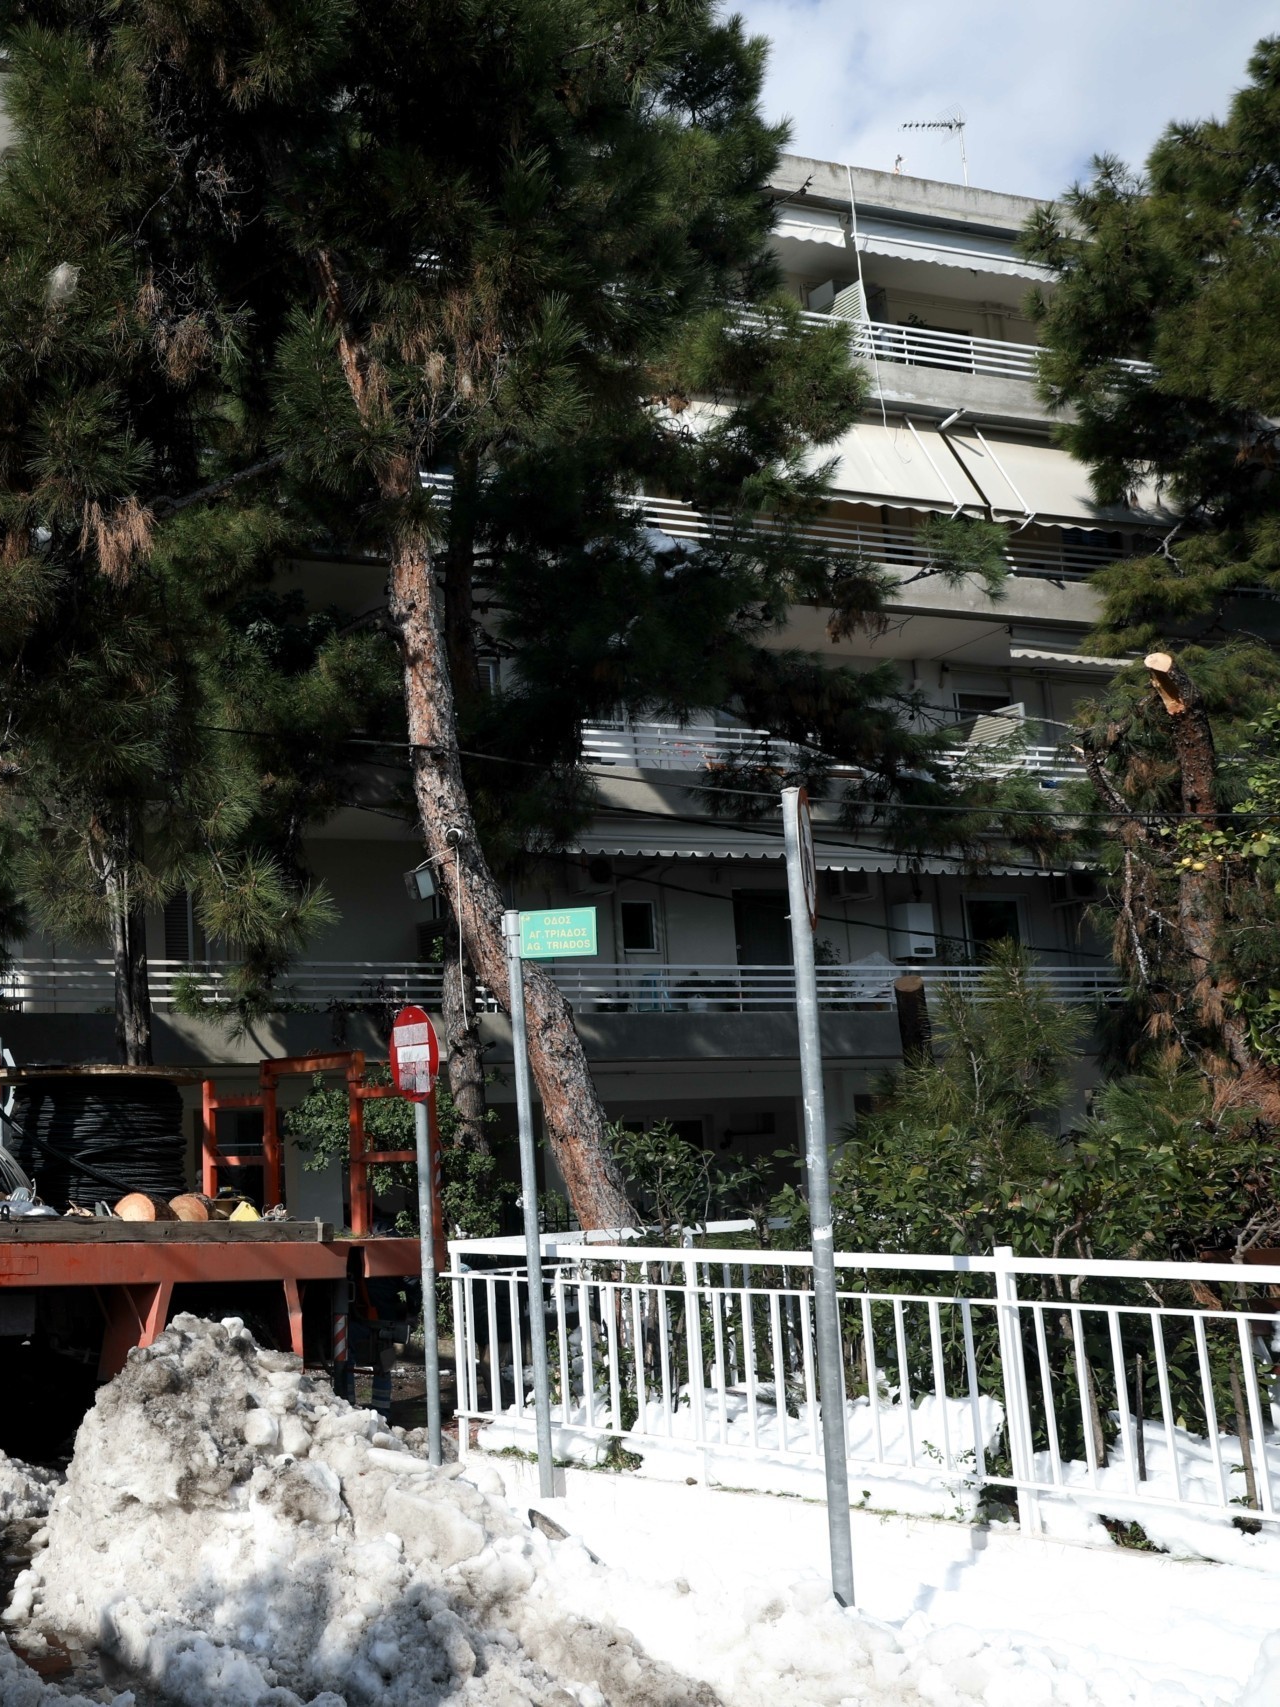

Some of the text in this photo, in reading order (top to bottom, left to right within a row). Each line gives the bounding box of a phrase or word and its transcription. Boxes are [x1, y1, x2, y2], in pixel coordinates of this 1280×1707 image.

[544, 916, 572, 925] ΟΔΟΣ
[526, 939, 591, 951] AG. TRIADOS
